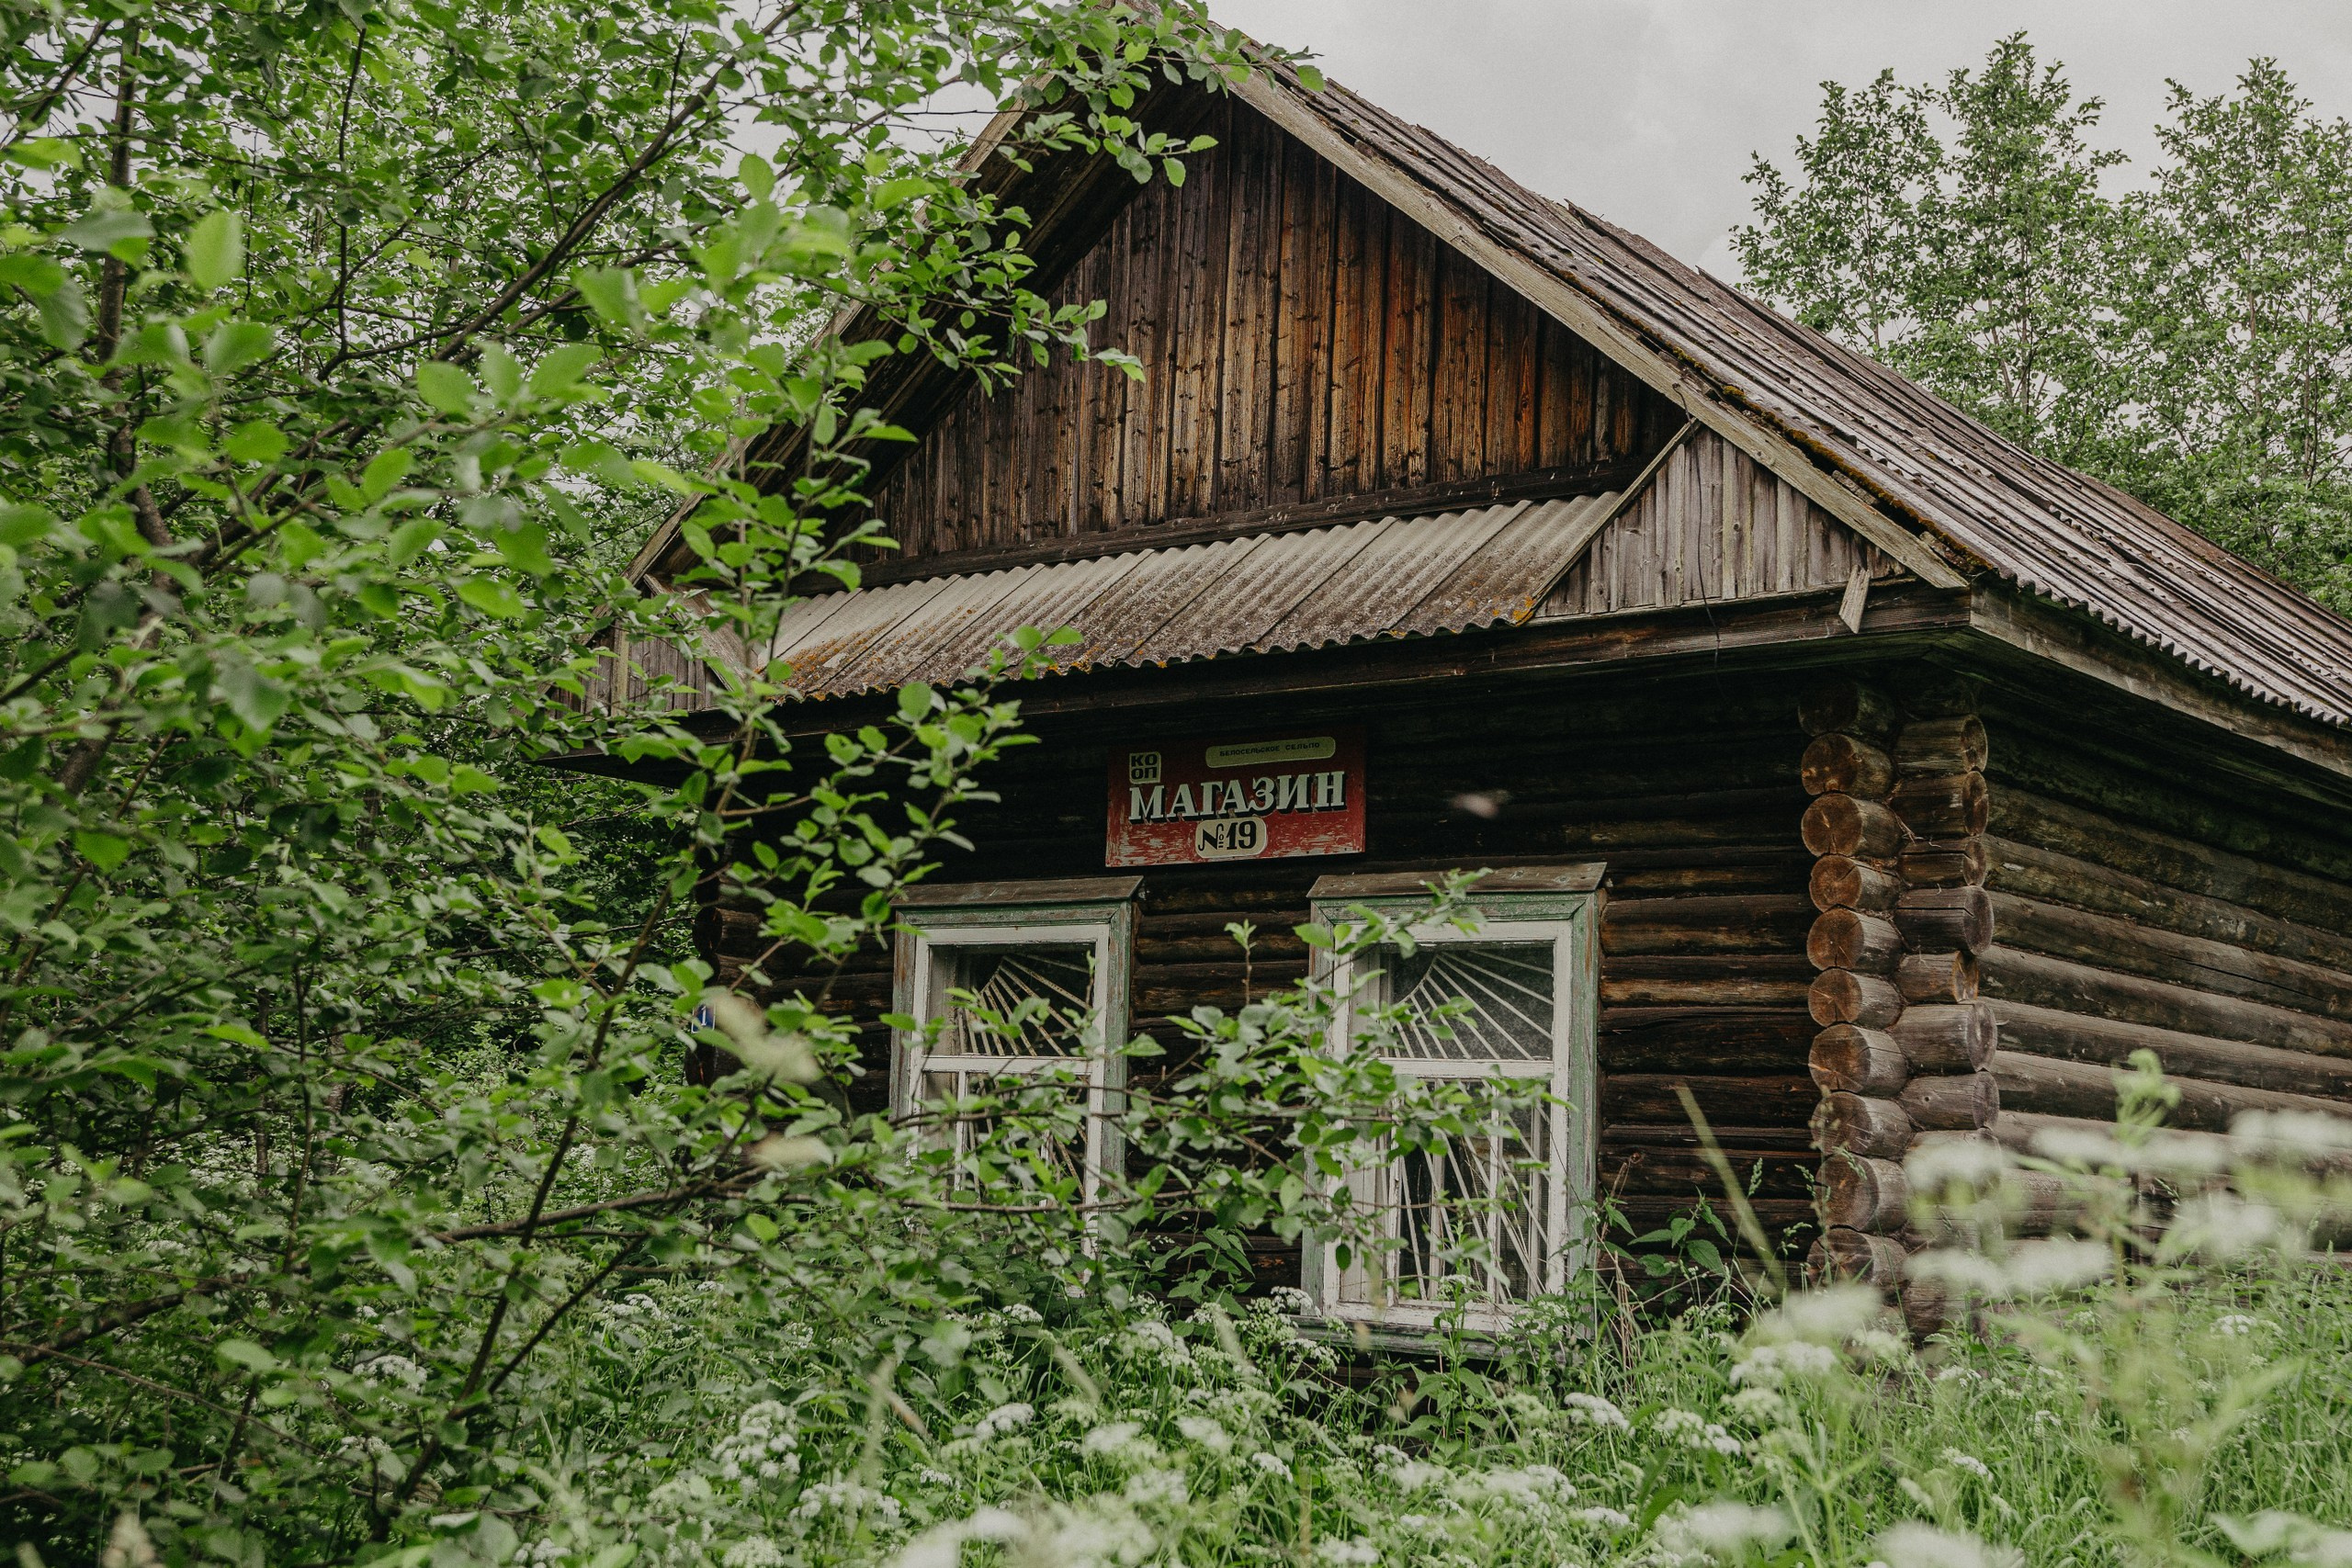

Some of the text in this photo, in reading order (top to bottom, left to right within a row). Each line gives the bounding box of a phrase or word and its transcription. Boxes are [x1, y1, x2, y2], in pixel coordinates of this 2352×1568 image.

[1285, 742, 1320, 751] СЕЛЬПО
[1130, 754, 1158, 766] КО
[1130, 767, 1158, 781] ОП
[1128, 771, 1347, 822] МАГАЗИН
